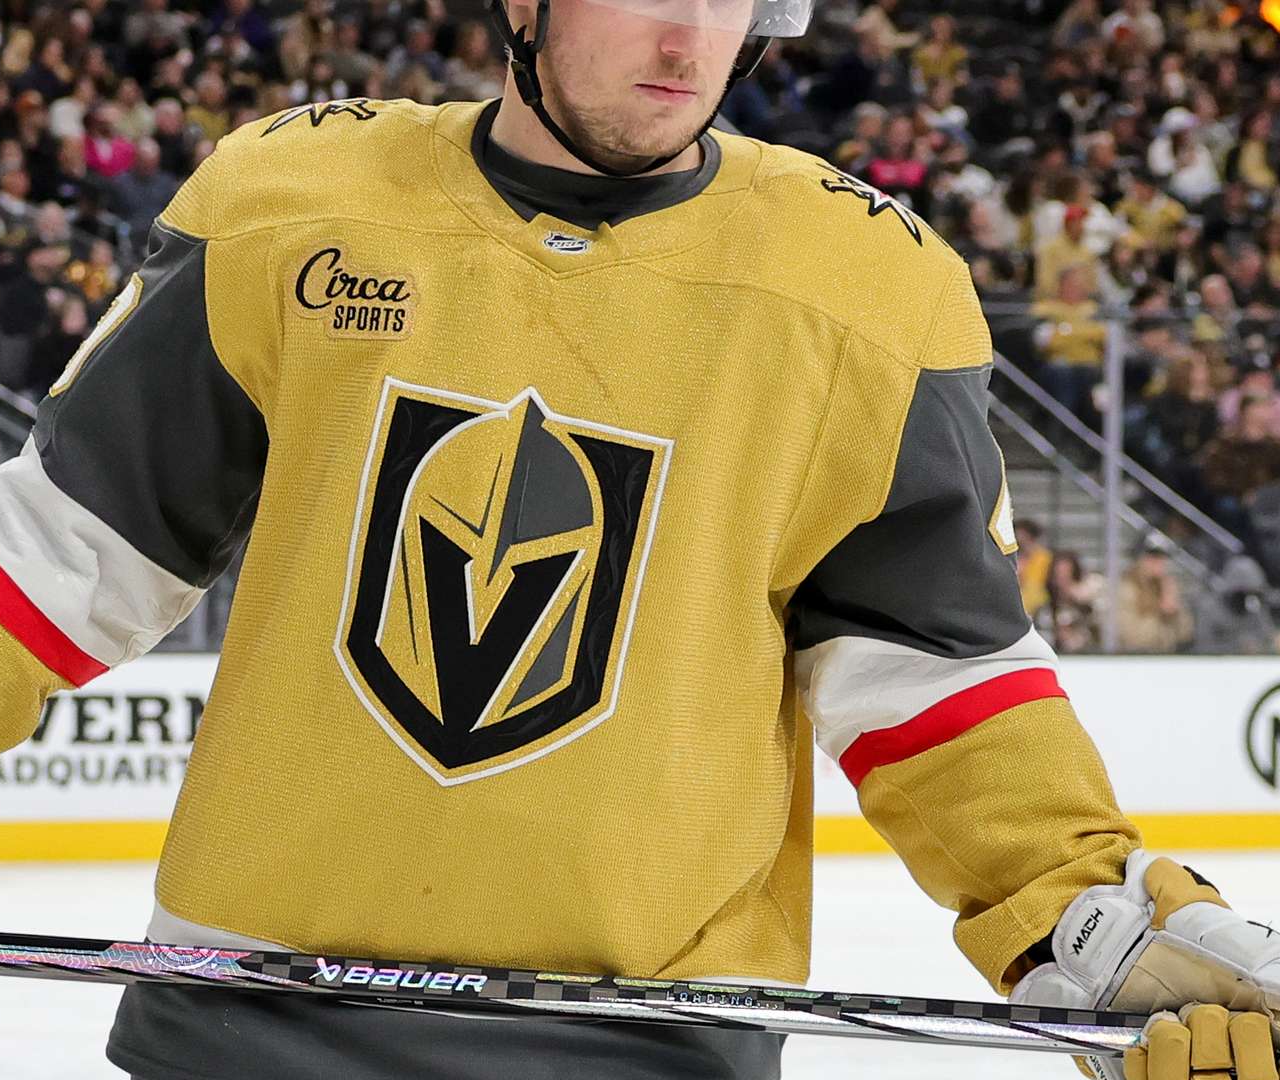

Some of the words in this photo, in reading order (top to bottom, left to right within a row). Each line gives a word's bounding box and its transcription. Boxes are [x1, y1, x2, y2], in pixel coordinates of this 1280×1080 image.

[296, 248, 410, 309] Circa
[333, 305, 405, 331] SPORTS
[1071, 908, 1104, 956] MACH
[342, 966, 488, 992] BAUER
